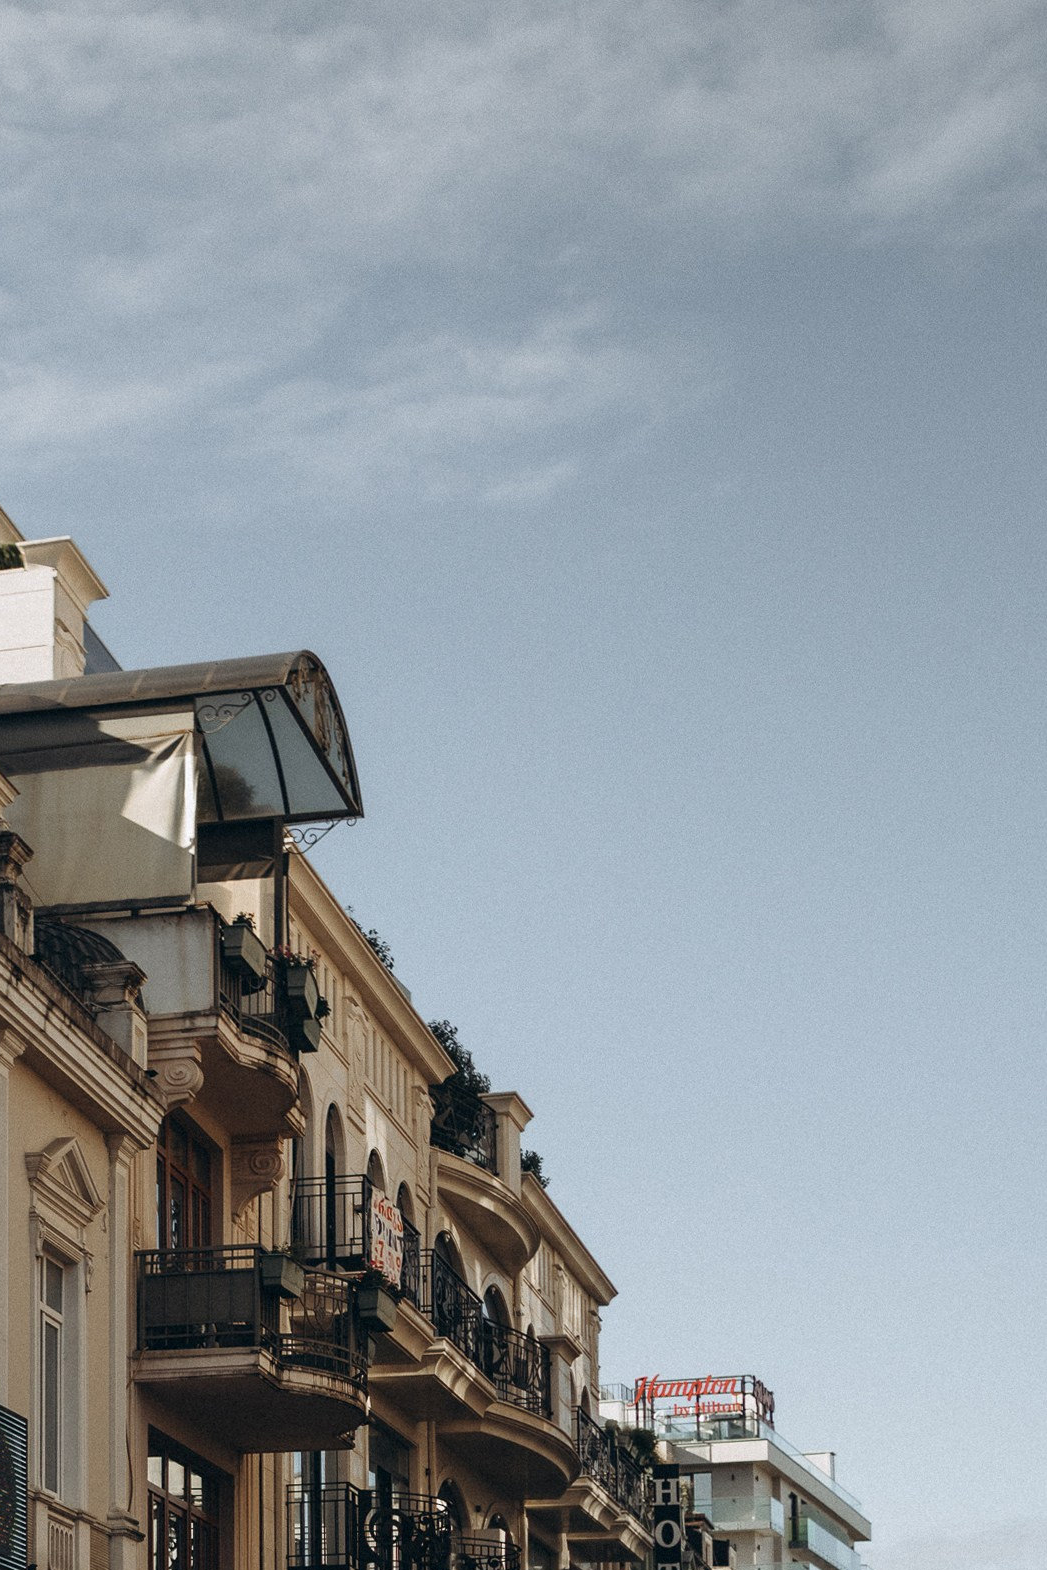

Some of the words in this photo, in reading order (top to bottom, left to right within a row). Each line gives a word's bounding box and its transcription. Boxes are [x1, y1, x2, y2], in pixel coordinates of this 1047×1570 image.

[626, 1374, 741, 1407] Hampton
[674, 1403, 691, 1418] by
[694, 1401, 743, 1416] Hilton
